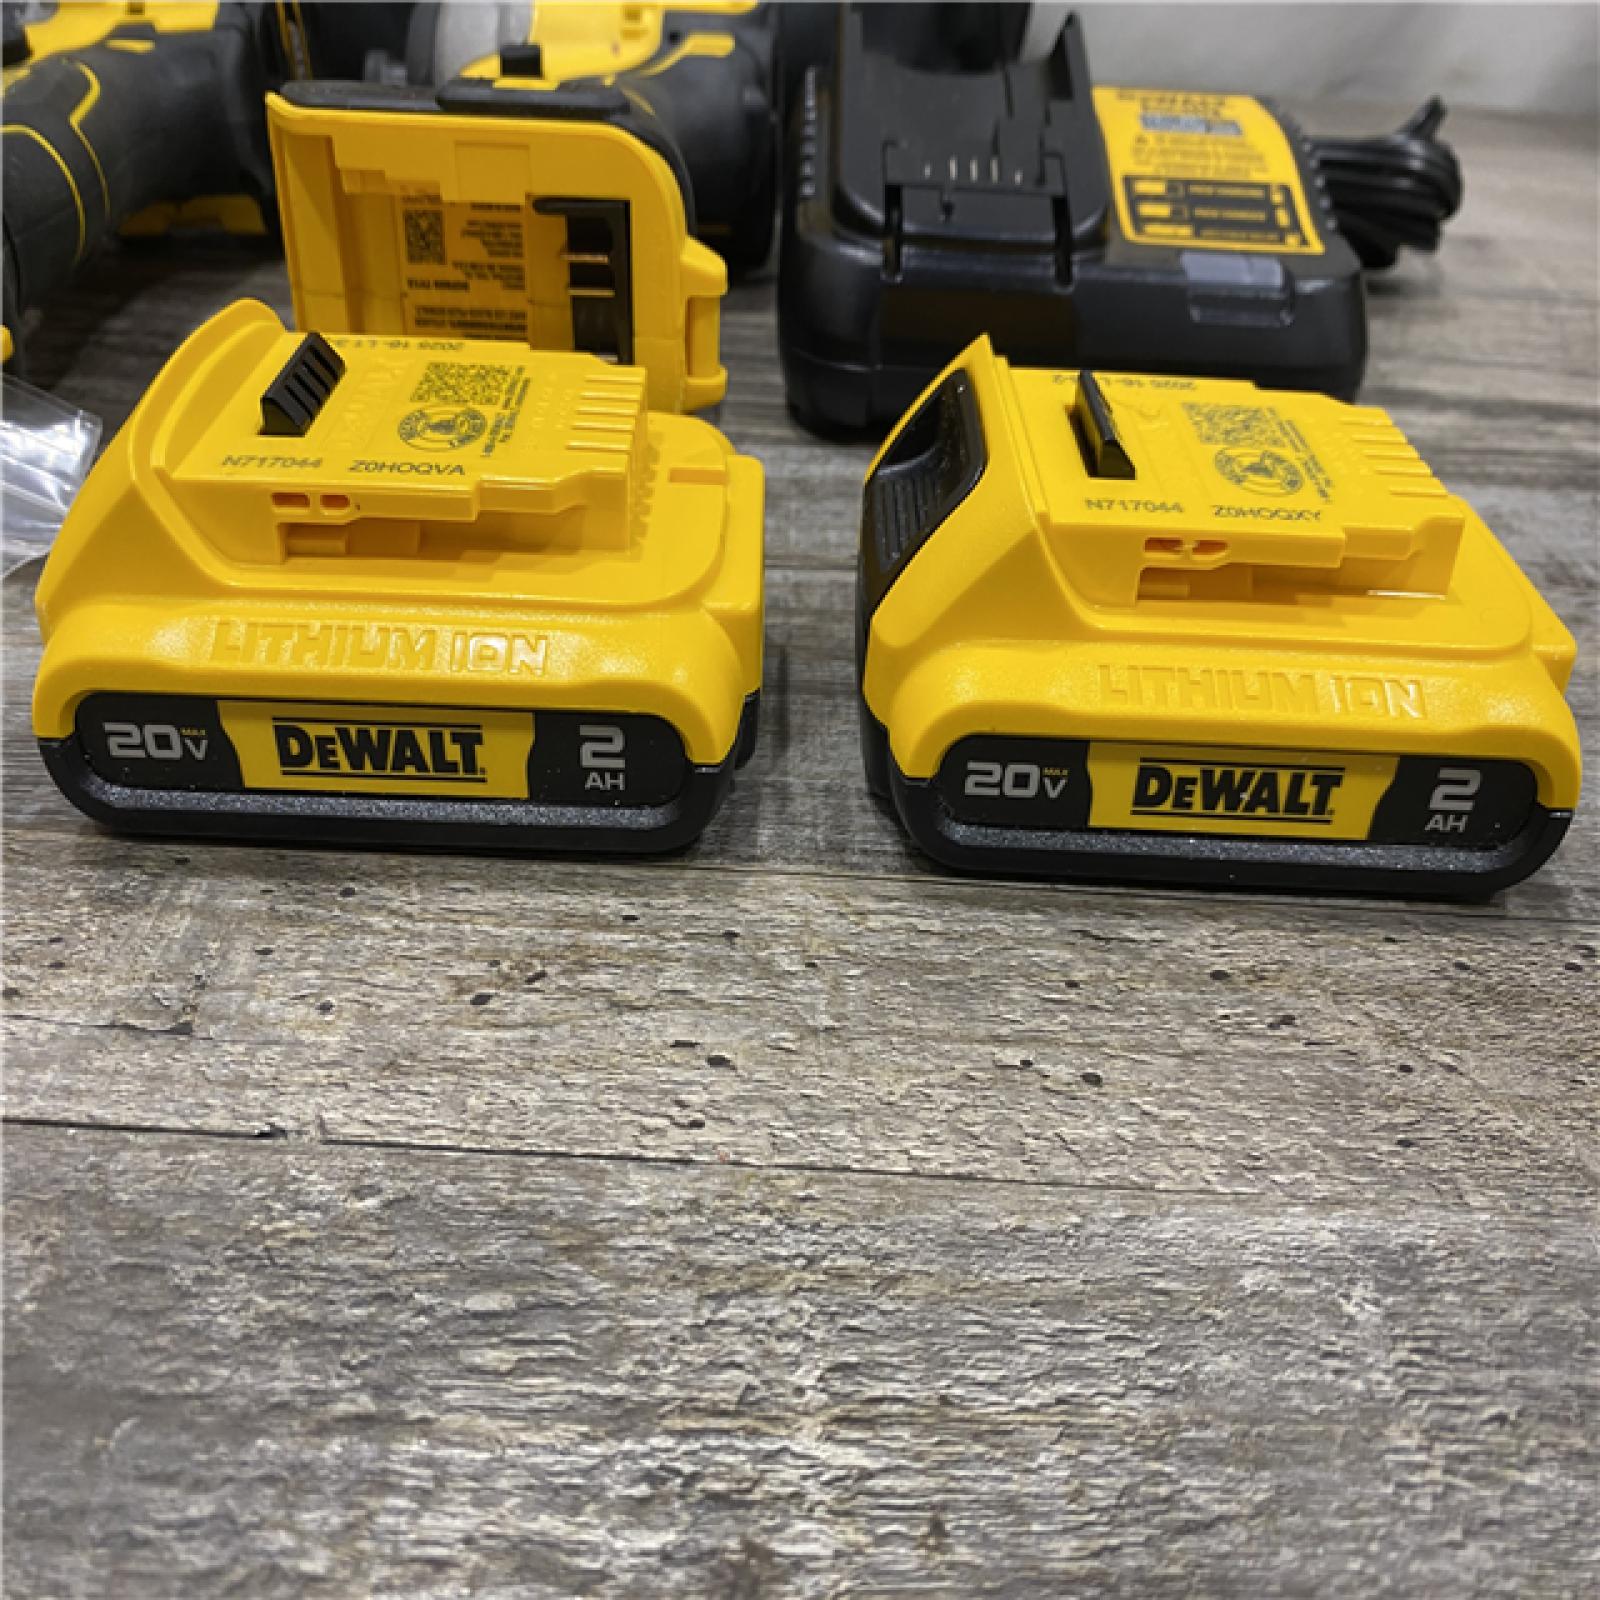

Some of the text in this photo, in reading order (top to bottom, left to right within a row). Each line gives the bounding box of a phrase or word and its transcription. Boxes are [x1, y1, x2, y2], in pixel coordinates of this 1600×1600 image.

[212, 620, 549, 677] LITHIUM ION
[1097, 665, 1427, 720] LITHIUM ION
[578, 724, 626, 769] 2
[584, 772, 626, 791] AH
[1430, 768, 1481, 811] 2
[1424, 814, 1467, 834] AH
